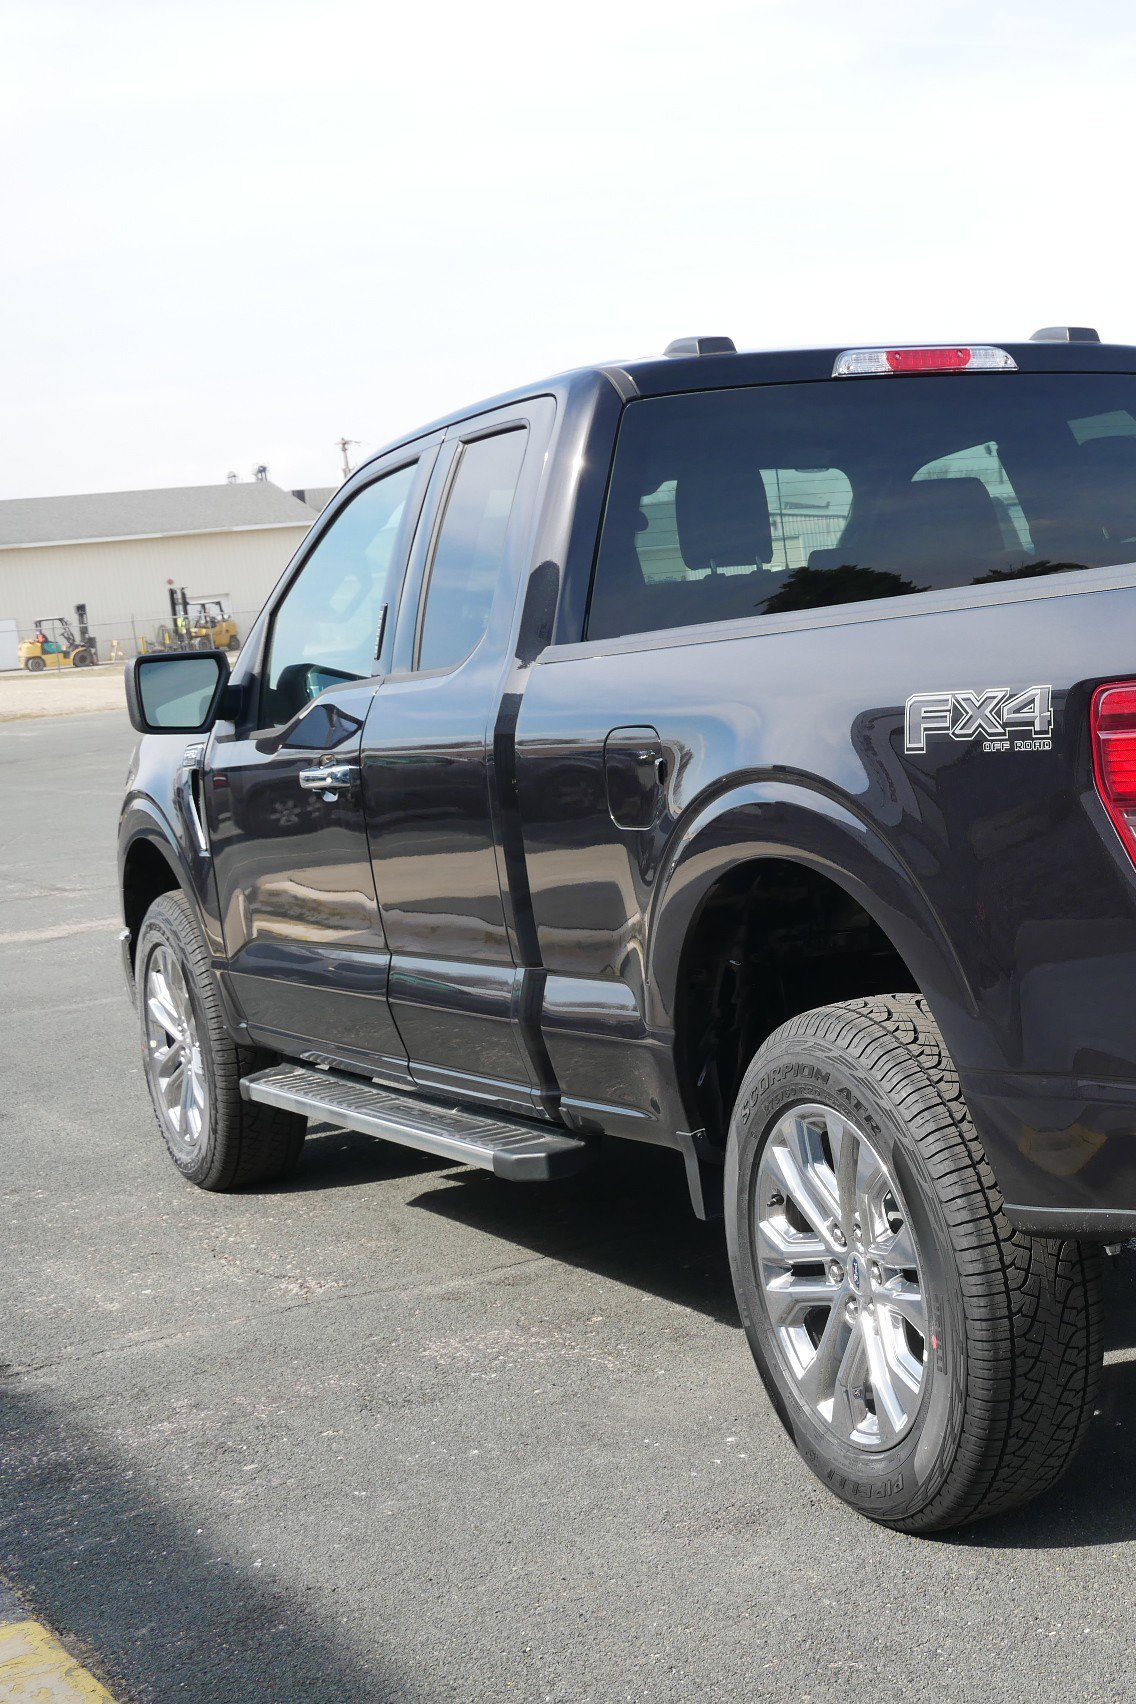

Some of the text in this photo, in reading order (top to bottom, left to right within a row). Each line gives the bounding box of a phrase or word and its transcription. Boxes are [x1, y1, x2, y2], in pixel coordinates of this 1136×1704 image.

[904, 685, 1053, 754] FX4
[983, 740, 1052, 752] OFF ROAD
[741, 1063, 831, 1126] SCORPION
[836, 1086, 882, 1136] ATR
